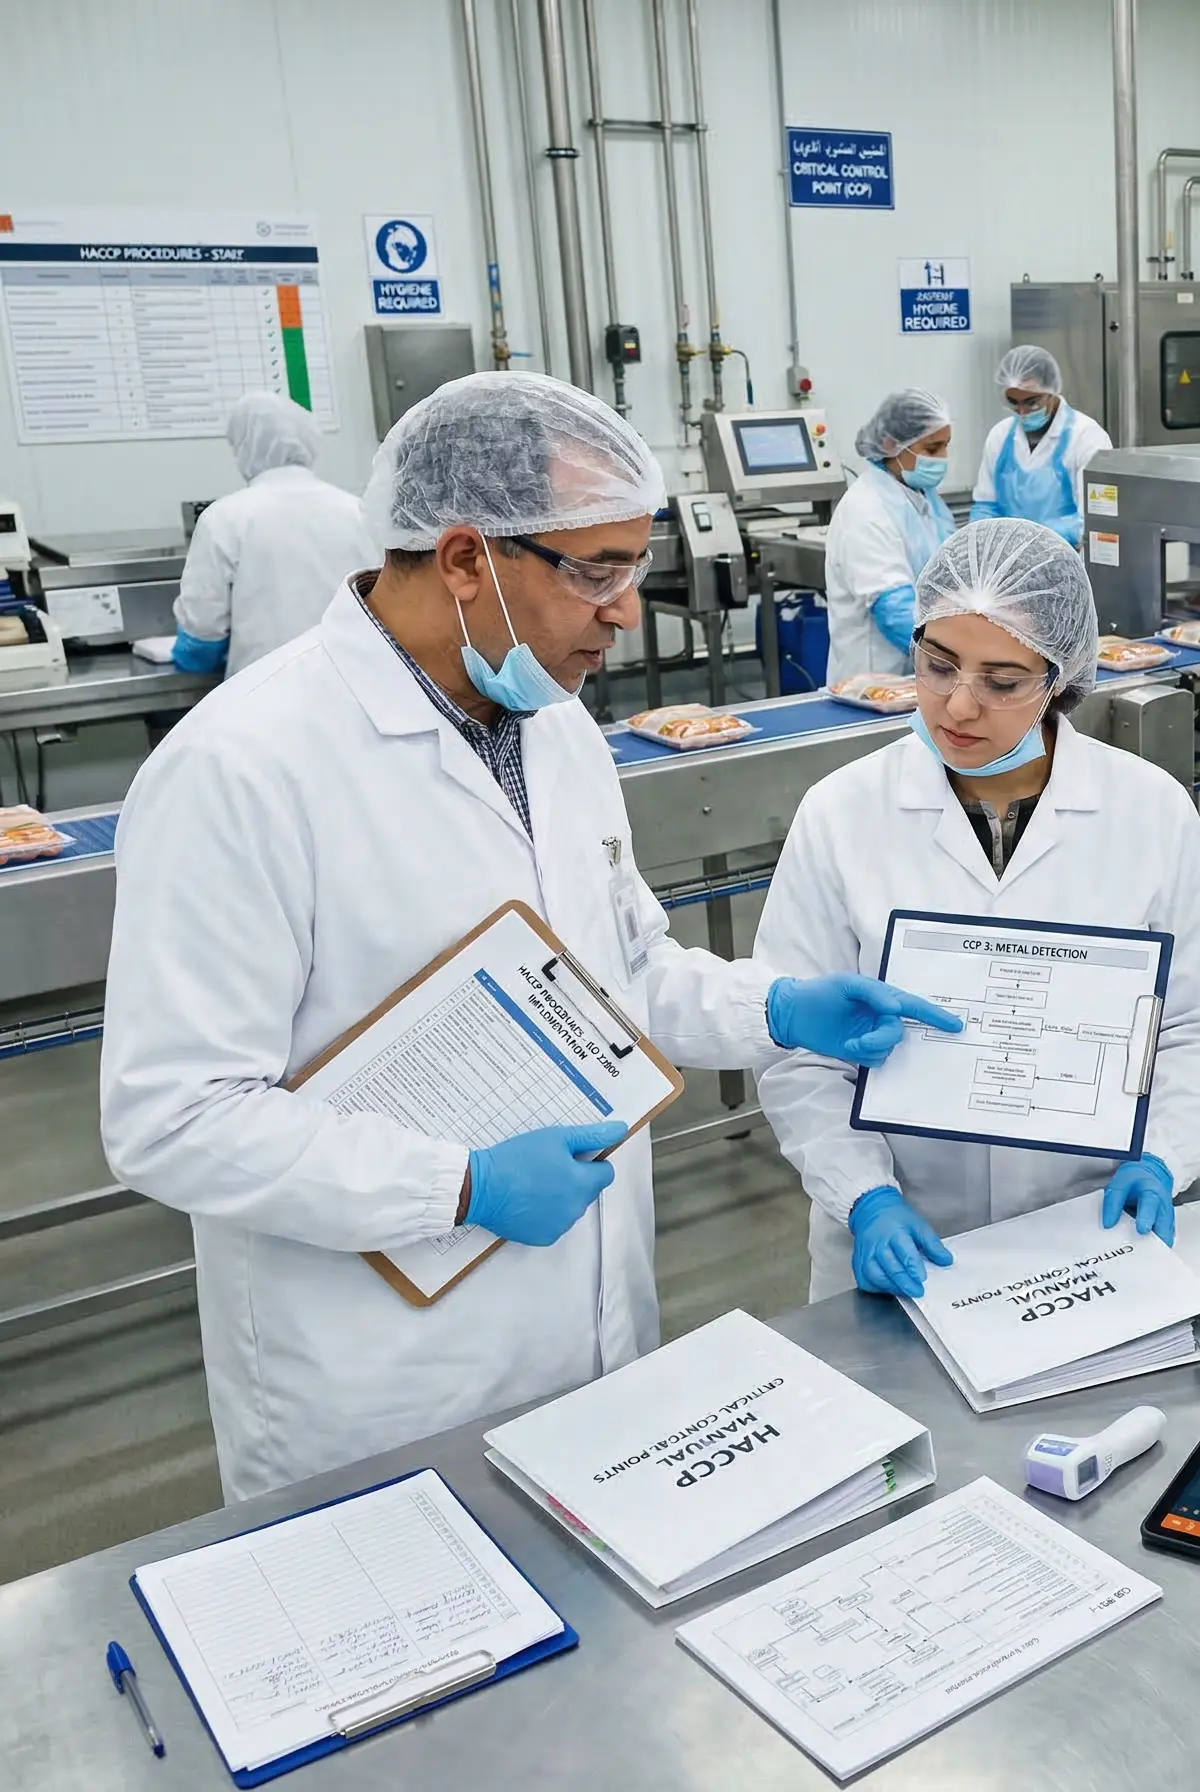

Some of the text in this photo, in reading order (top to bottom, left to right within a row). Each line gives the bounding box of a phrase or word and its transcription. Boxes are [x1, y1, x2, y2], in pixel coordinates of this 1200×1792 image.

[80, 247, 121, 260] HACCP
[904, 316, 968, 329] REQUIRED
[963, 940, 1088, 959] CCP 3: METAL DETECTION
[951, 1288, 1002, 1309] POINTS
[1021, 1281, 1117, 1322] HACCP
[593, 1448, 651, 1484] POINTS
[676, 1423, 781, 1489] HACCP
